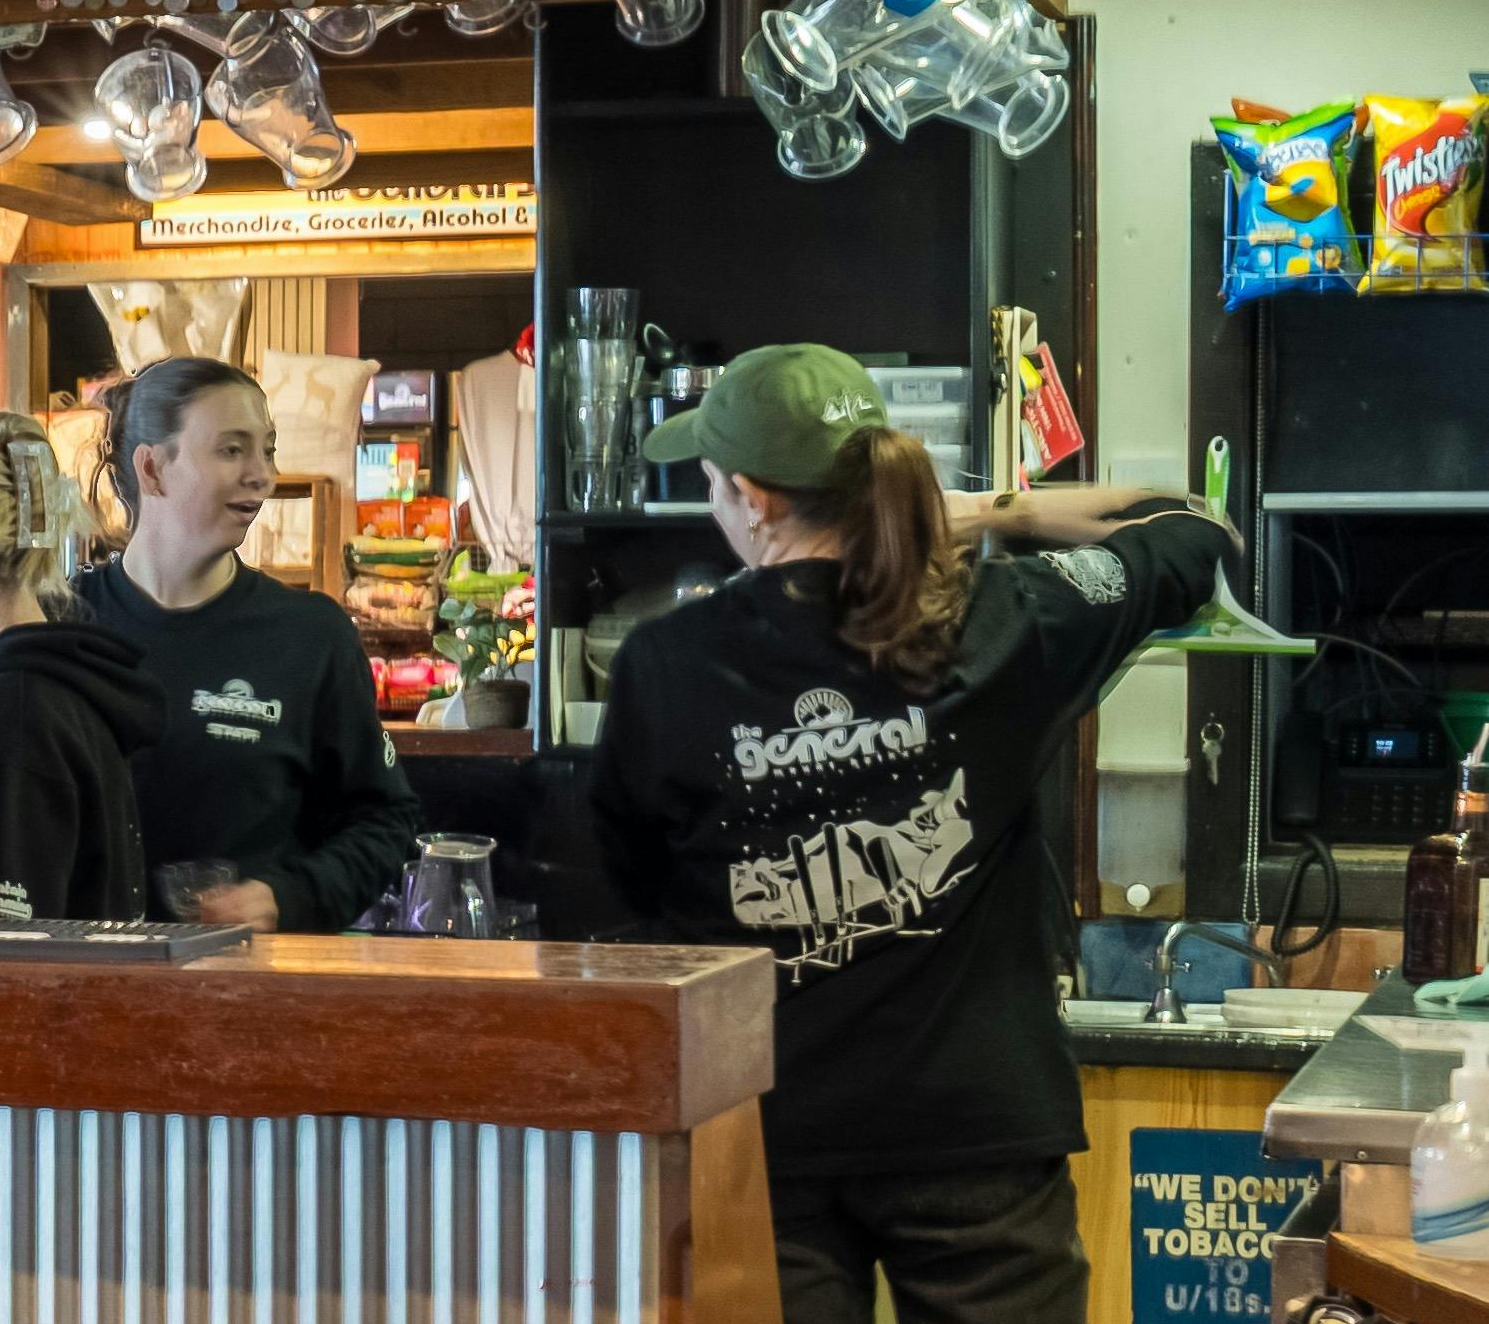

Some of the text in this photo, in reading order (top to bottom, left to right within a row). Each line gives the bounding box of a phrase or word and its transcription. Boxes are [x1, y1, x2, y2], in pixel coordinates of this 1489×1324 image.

[152, 205, 529, 238] Merchandise, Groceries, Alcohol &
[731, 724, 763, 739] the
[734, 705, 927, 781] general
[1134, 1173, 1202, 1201] “WE
[1184, 1201, 1268, 1230] SELL
[1205, 1257, 1250, 1286] TO
